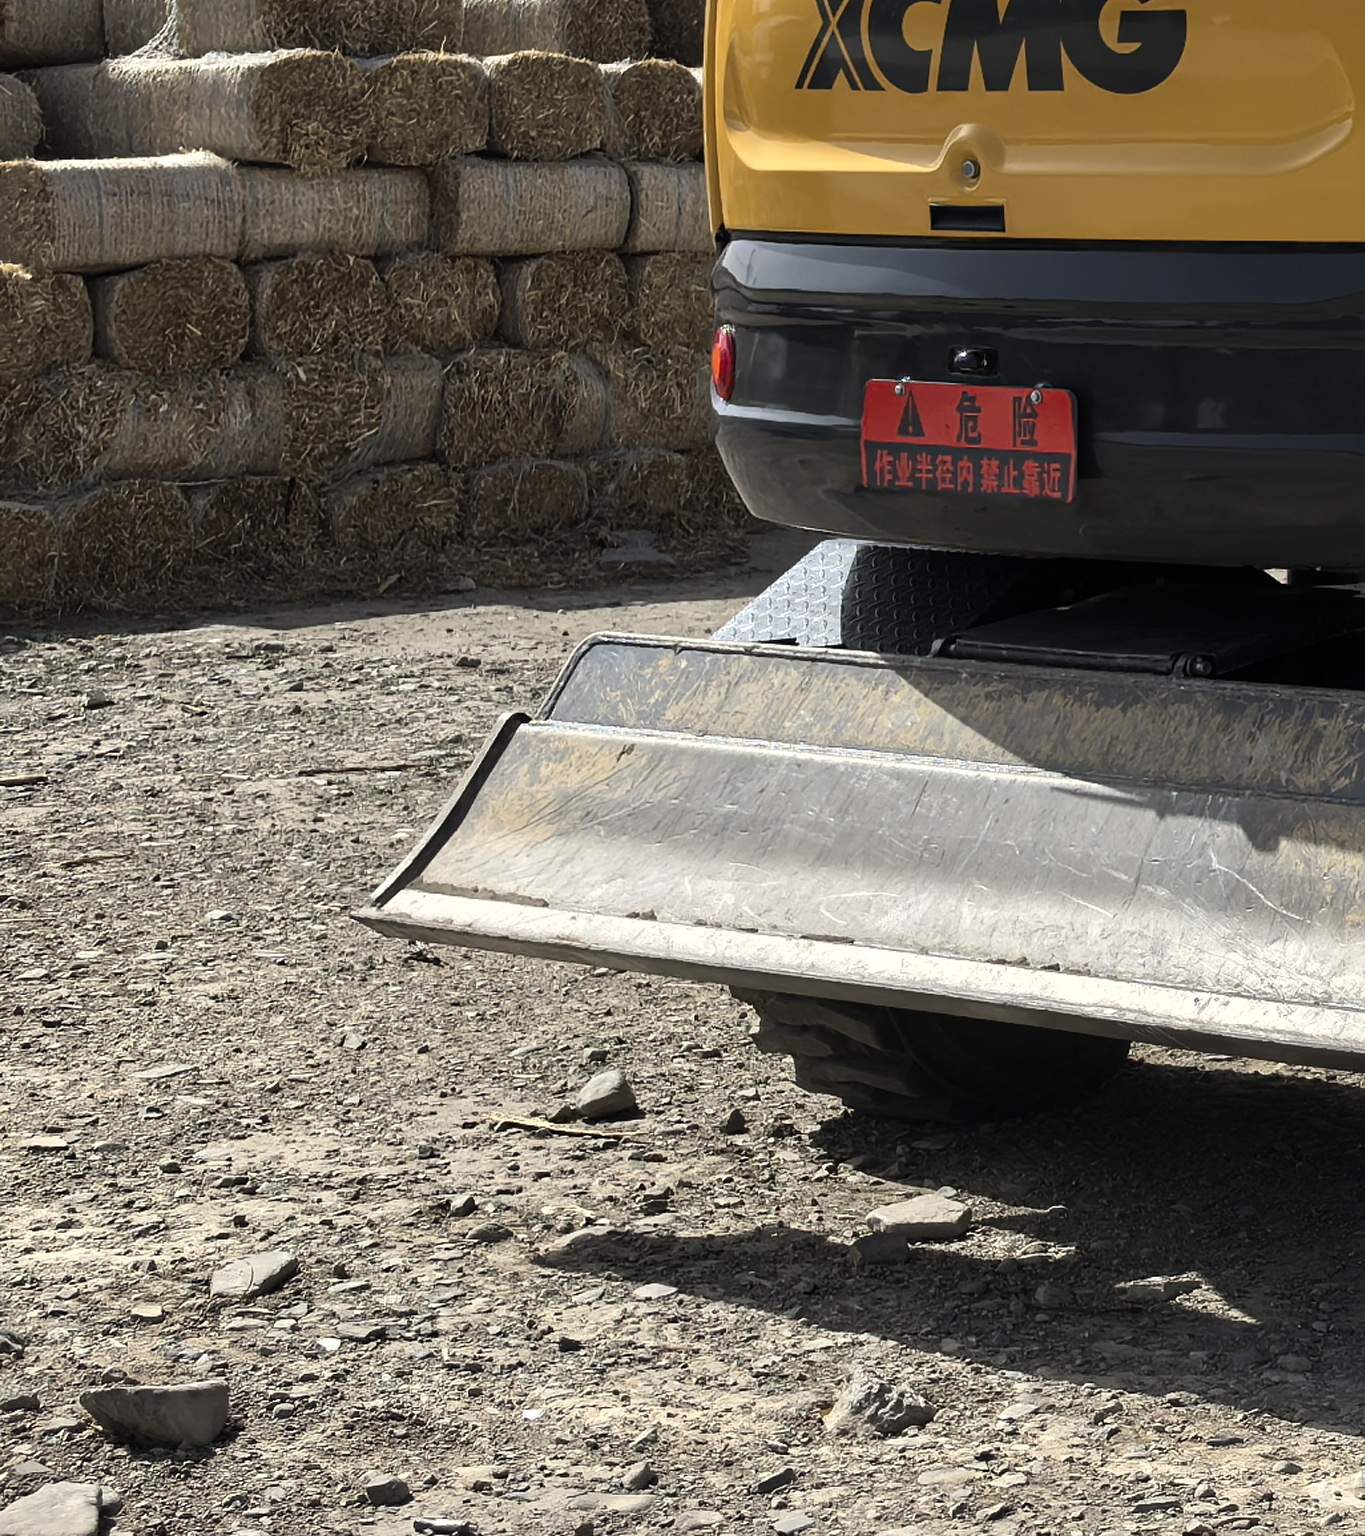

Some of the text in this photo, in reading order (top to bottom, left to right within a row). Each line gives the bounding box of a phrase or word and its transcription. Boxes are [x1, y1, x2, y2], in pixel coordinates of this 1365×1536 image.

[956, 391, 1038, 448] 危险
[874, 449, 1062, 498] 作业半径内禁止靠近
